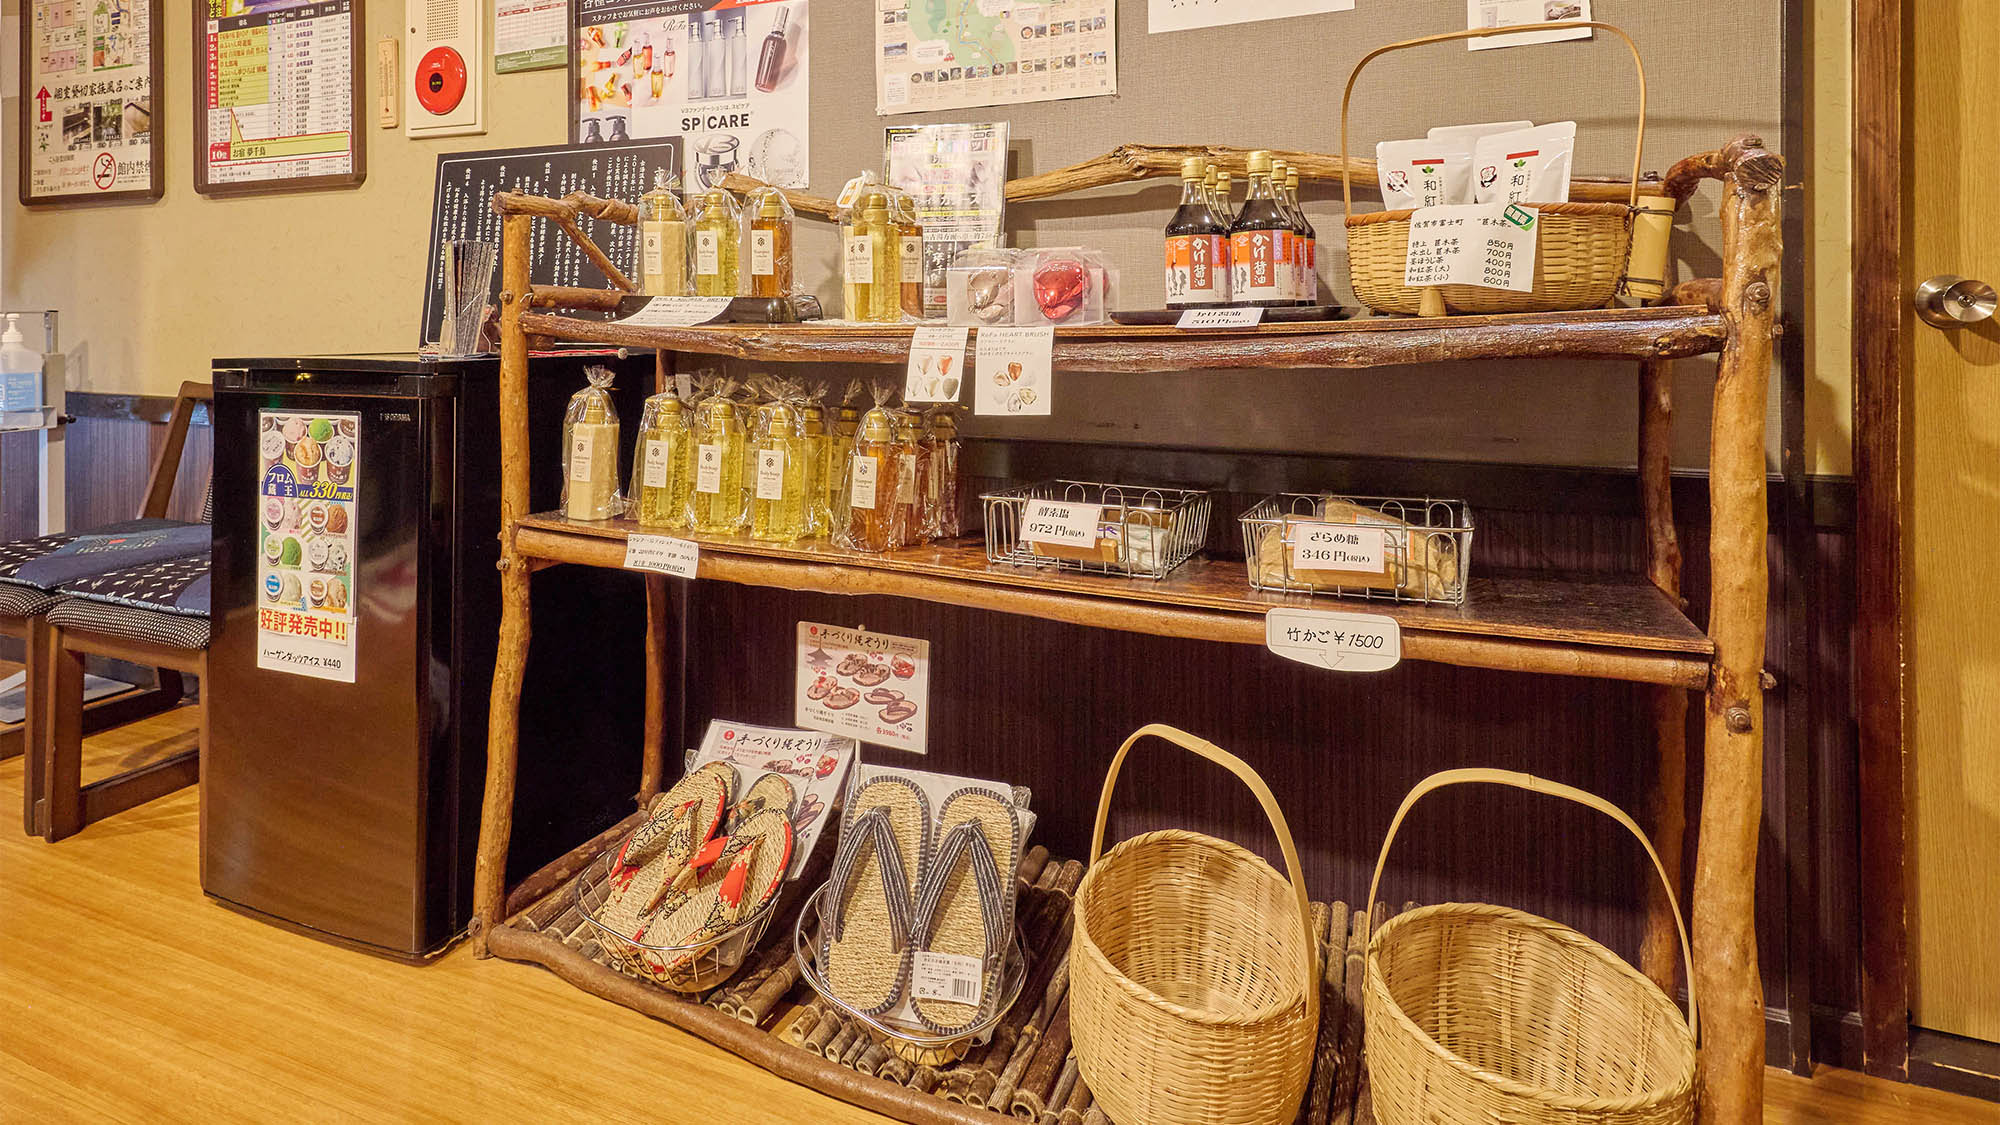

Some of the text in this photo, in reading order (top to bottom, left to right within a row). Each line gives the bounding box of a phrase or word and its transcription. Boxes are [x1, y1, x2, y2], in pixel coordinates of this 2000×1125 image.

[637, 160, 646, 203] 古湯温泉の入
[1414, 218, 1464, 229] 佐賀市富士町
[1487, 239, 1514, 251] 850円
[1252, 233, 1270, 285] かけ醤油
[1410, 248, 1432, 257] 水出し
[1486, 248, 1512, 260] 700円
[1192, 237, 1209, 287] かけ醤油
[1485, 258, 1512, 269] 400円
[1484, 266, 1511, 278] 800円
[1483, 276, 1510, 288] 600円
[268, 472, 293, 484] フロム
[1037, 506, 1070, 520] 酵素塩
[1310, 531, 1360, 546] ざらめ糖
[1302, 548, 1371, 563] 346円(税込)
[261, 608, 345, 640] 好評発売中!!
[323, 657, 342, 669] ¥440
